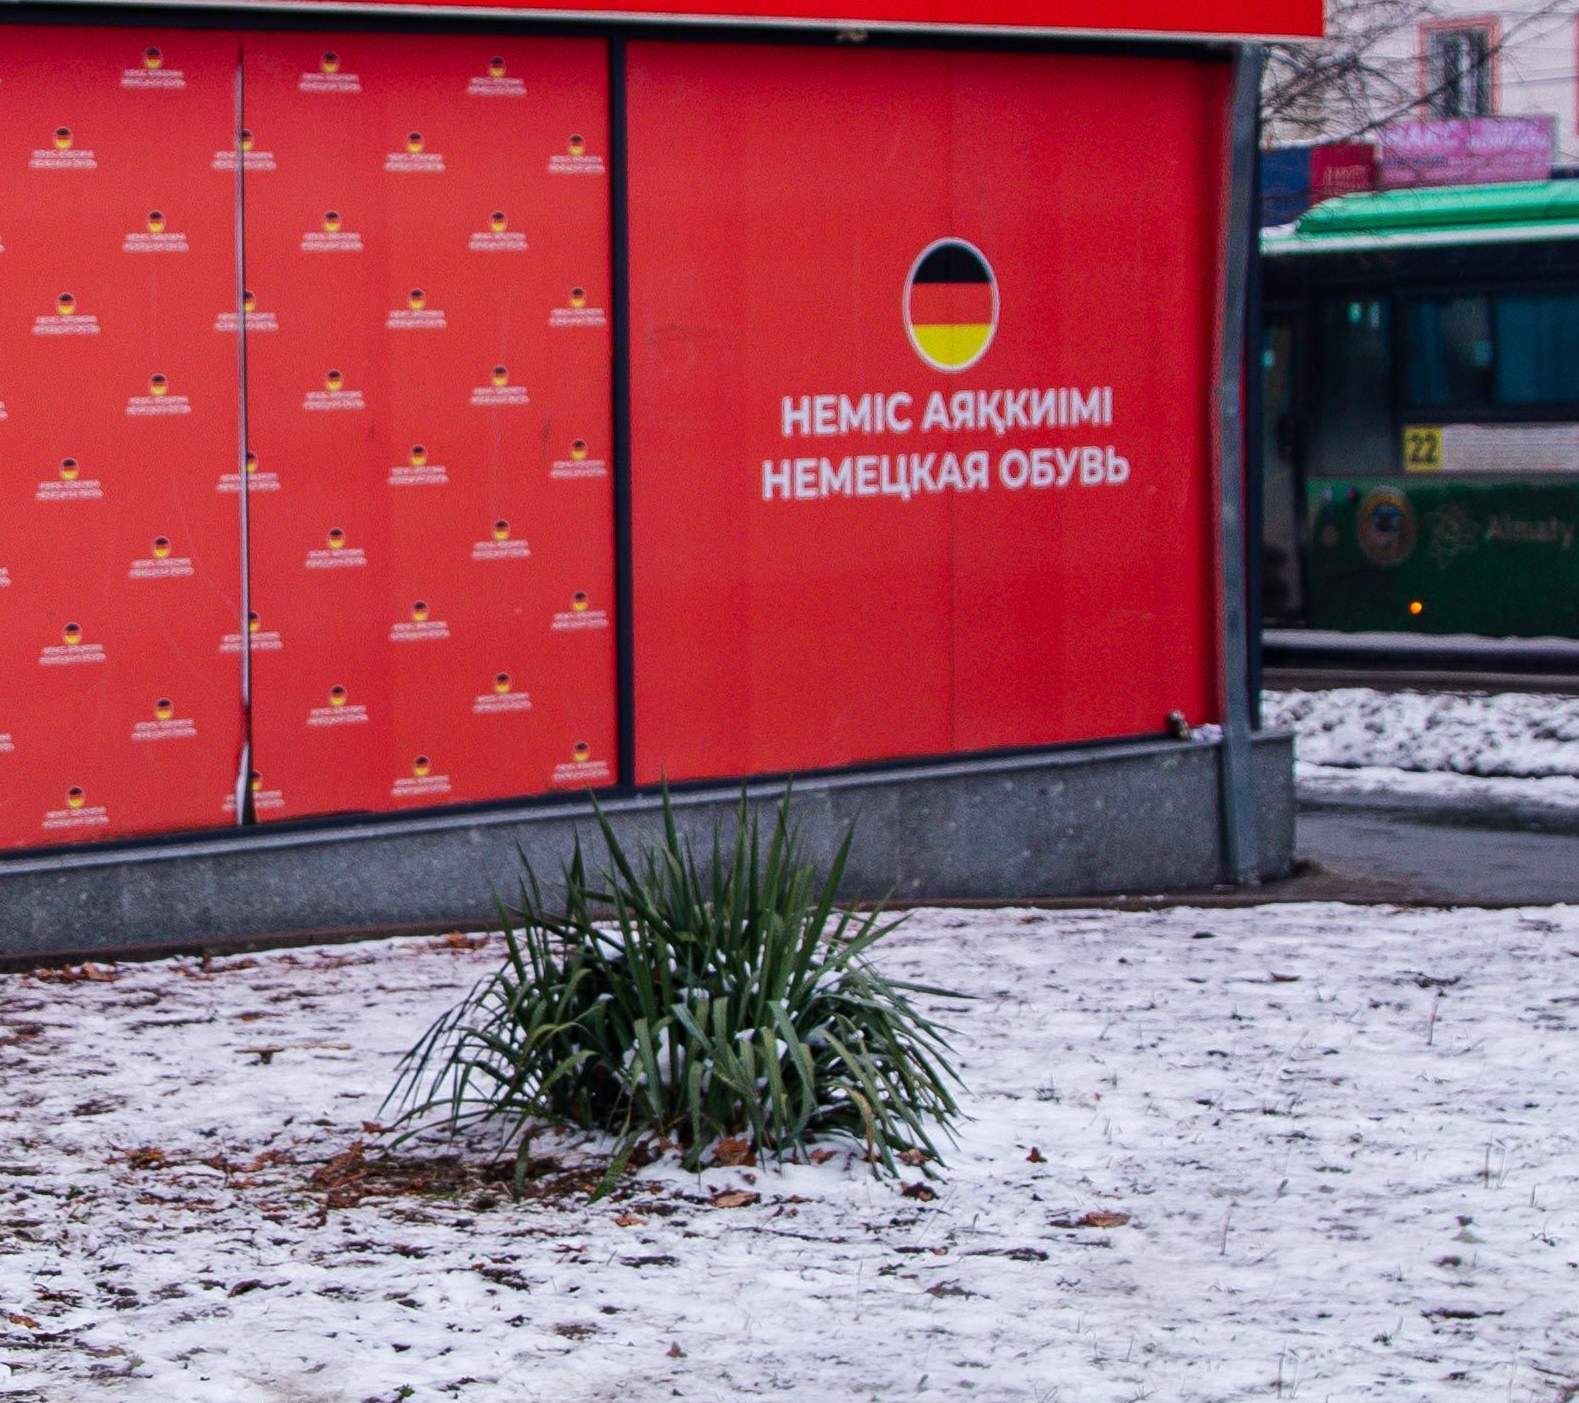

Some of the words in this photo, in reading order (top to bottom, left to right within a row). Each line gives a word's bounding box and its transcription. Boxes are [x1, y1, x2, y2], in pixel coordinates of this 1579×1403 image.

[781, 391, 913, 437] НЕМІС
[921, 386, 1115, 436] АЯҚКИІМІ
[1408, 432, 1440, 464] 22
[761, 451, 990, 501] НЕМЕЦКАЯ
[998, 445, 1132, 490] ОБУВЬ
[1487, 515, 1576, 550] Almaty
